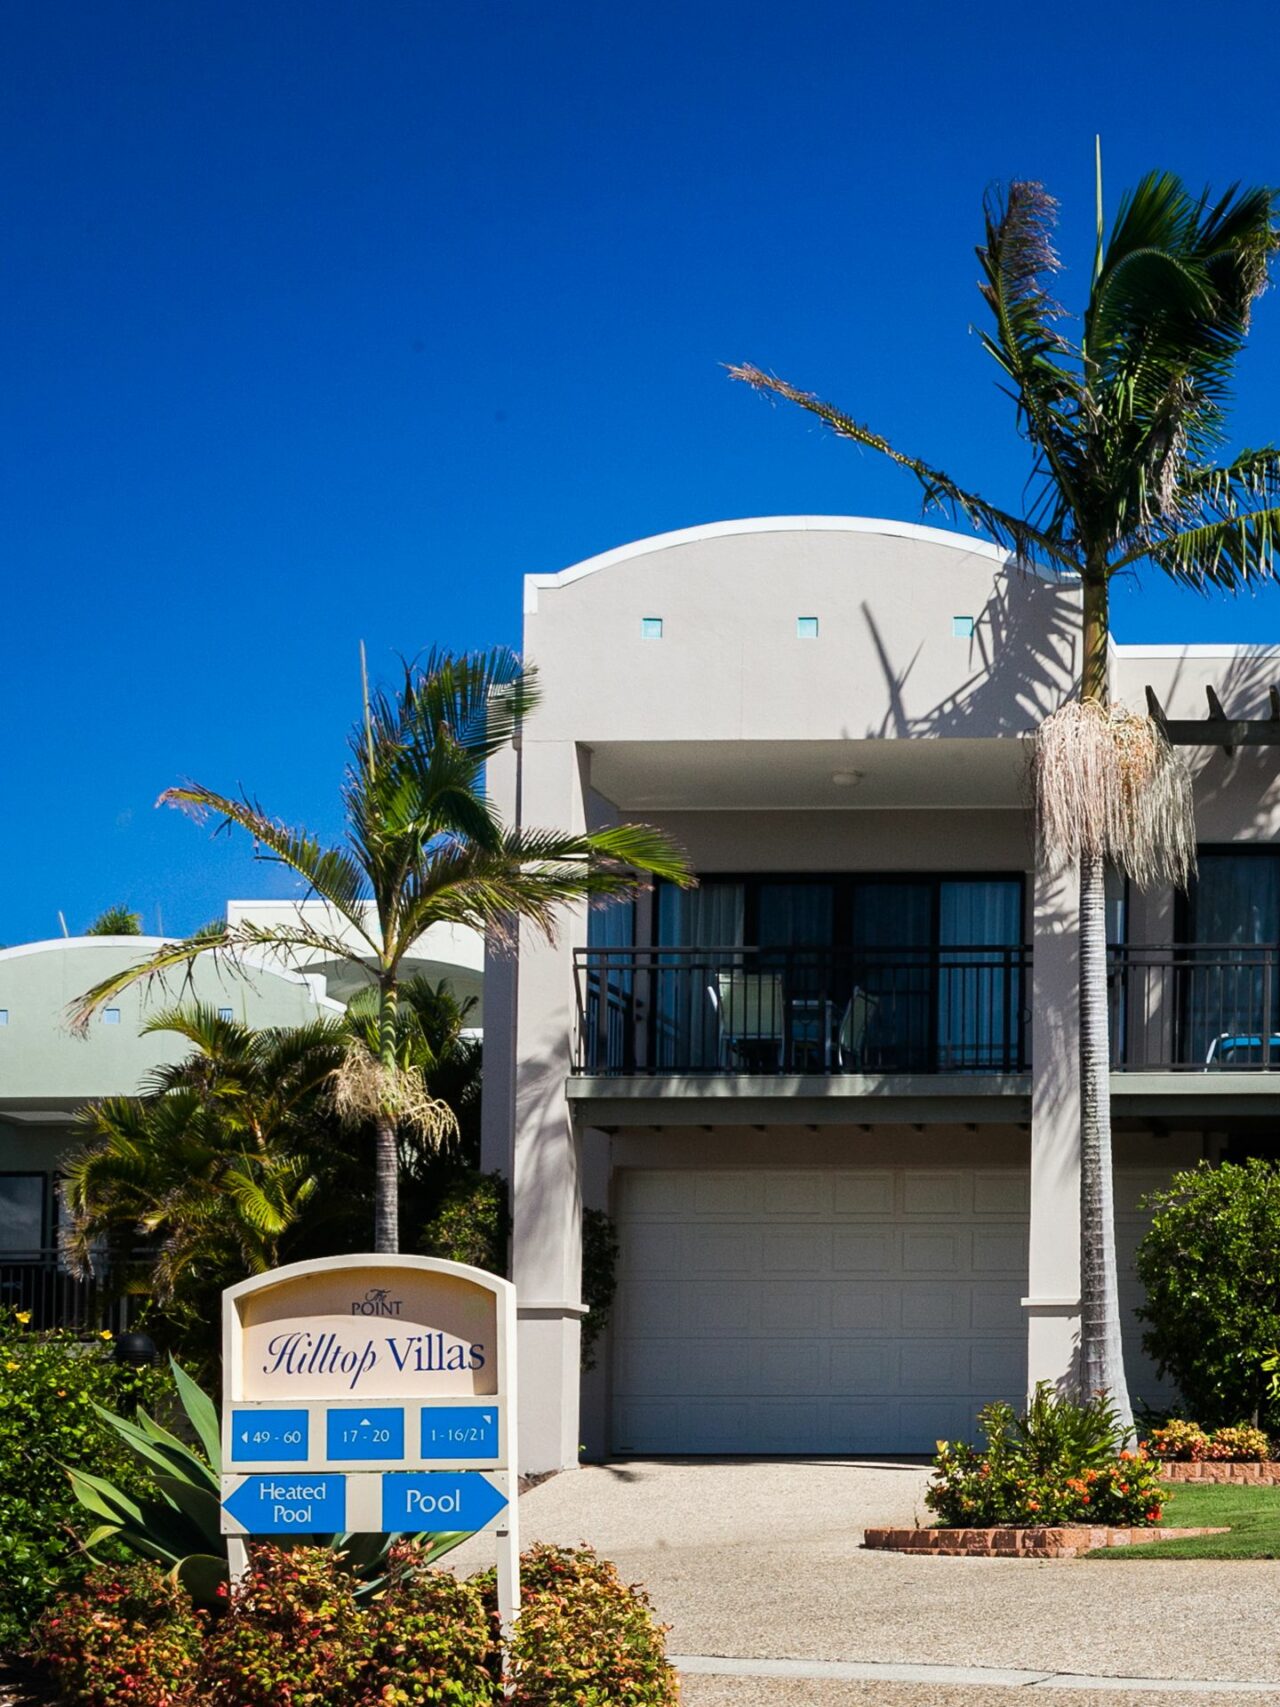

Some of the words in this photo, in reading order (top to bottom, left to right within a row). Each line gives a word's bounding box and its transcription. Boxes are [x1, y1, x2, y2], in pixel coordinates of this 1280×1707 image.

[364, 1288, 391, 1302] The
[352, 1301, 403, 1315] POINT
[262, 1331, 382, 1390] Hilltop
[385, 1333, 485, 1372] Villas
[253, 1431, 270, 1444] 49
[283, 1431, 301, 1444] 60
[343, 1430, 358, 1443] 17
[373, 1430, 390, 1443] 20
[259, 1482, 326, 1500] Heated
[406, 1489, 461, 1513] Pool
[273, 1505, 312, 1523] Pool
